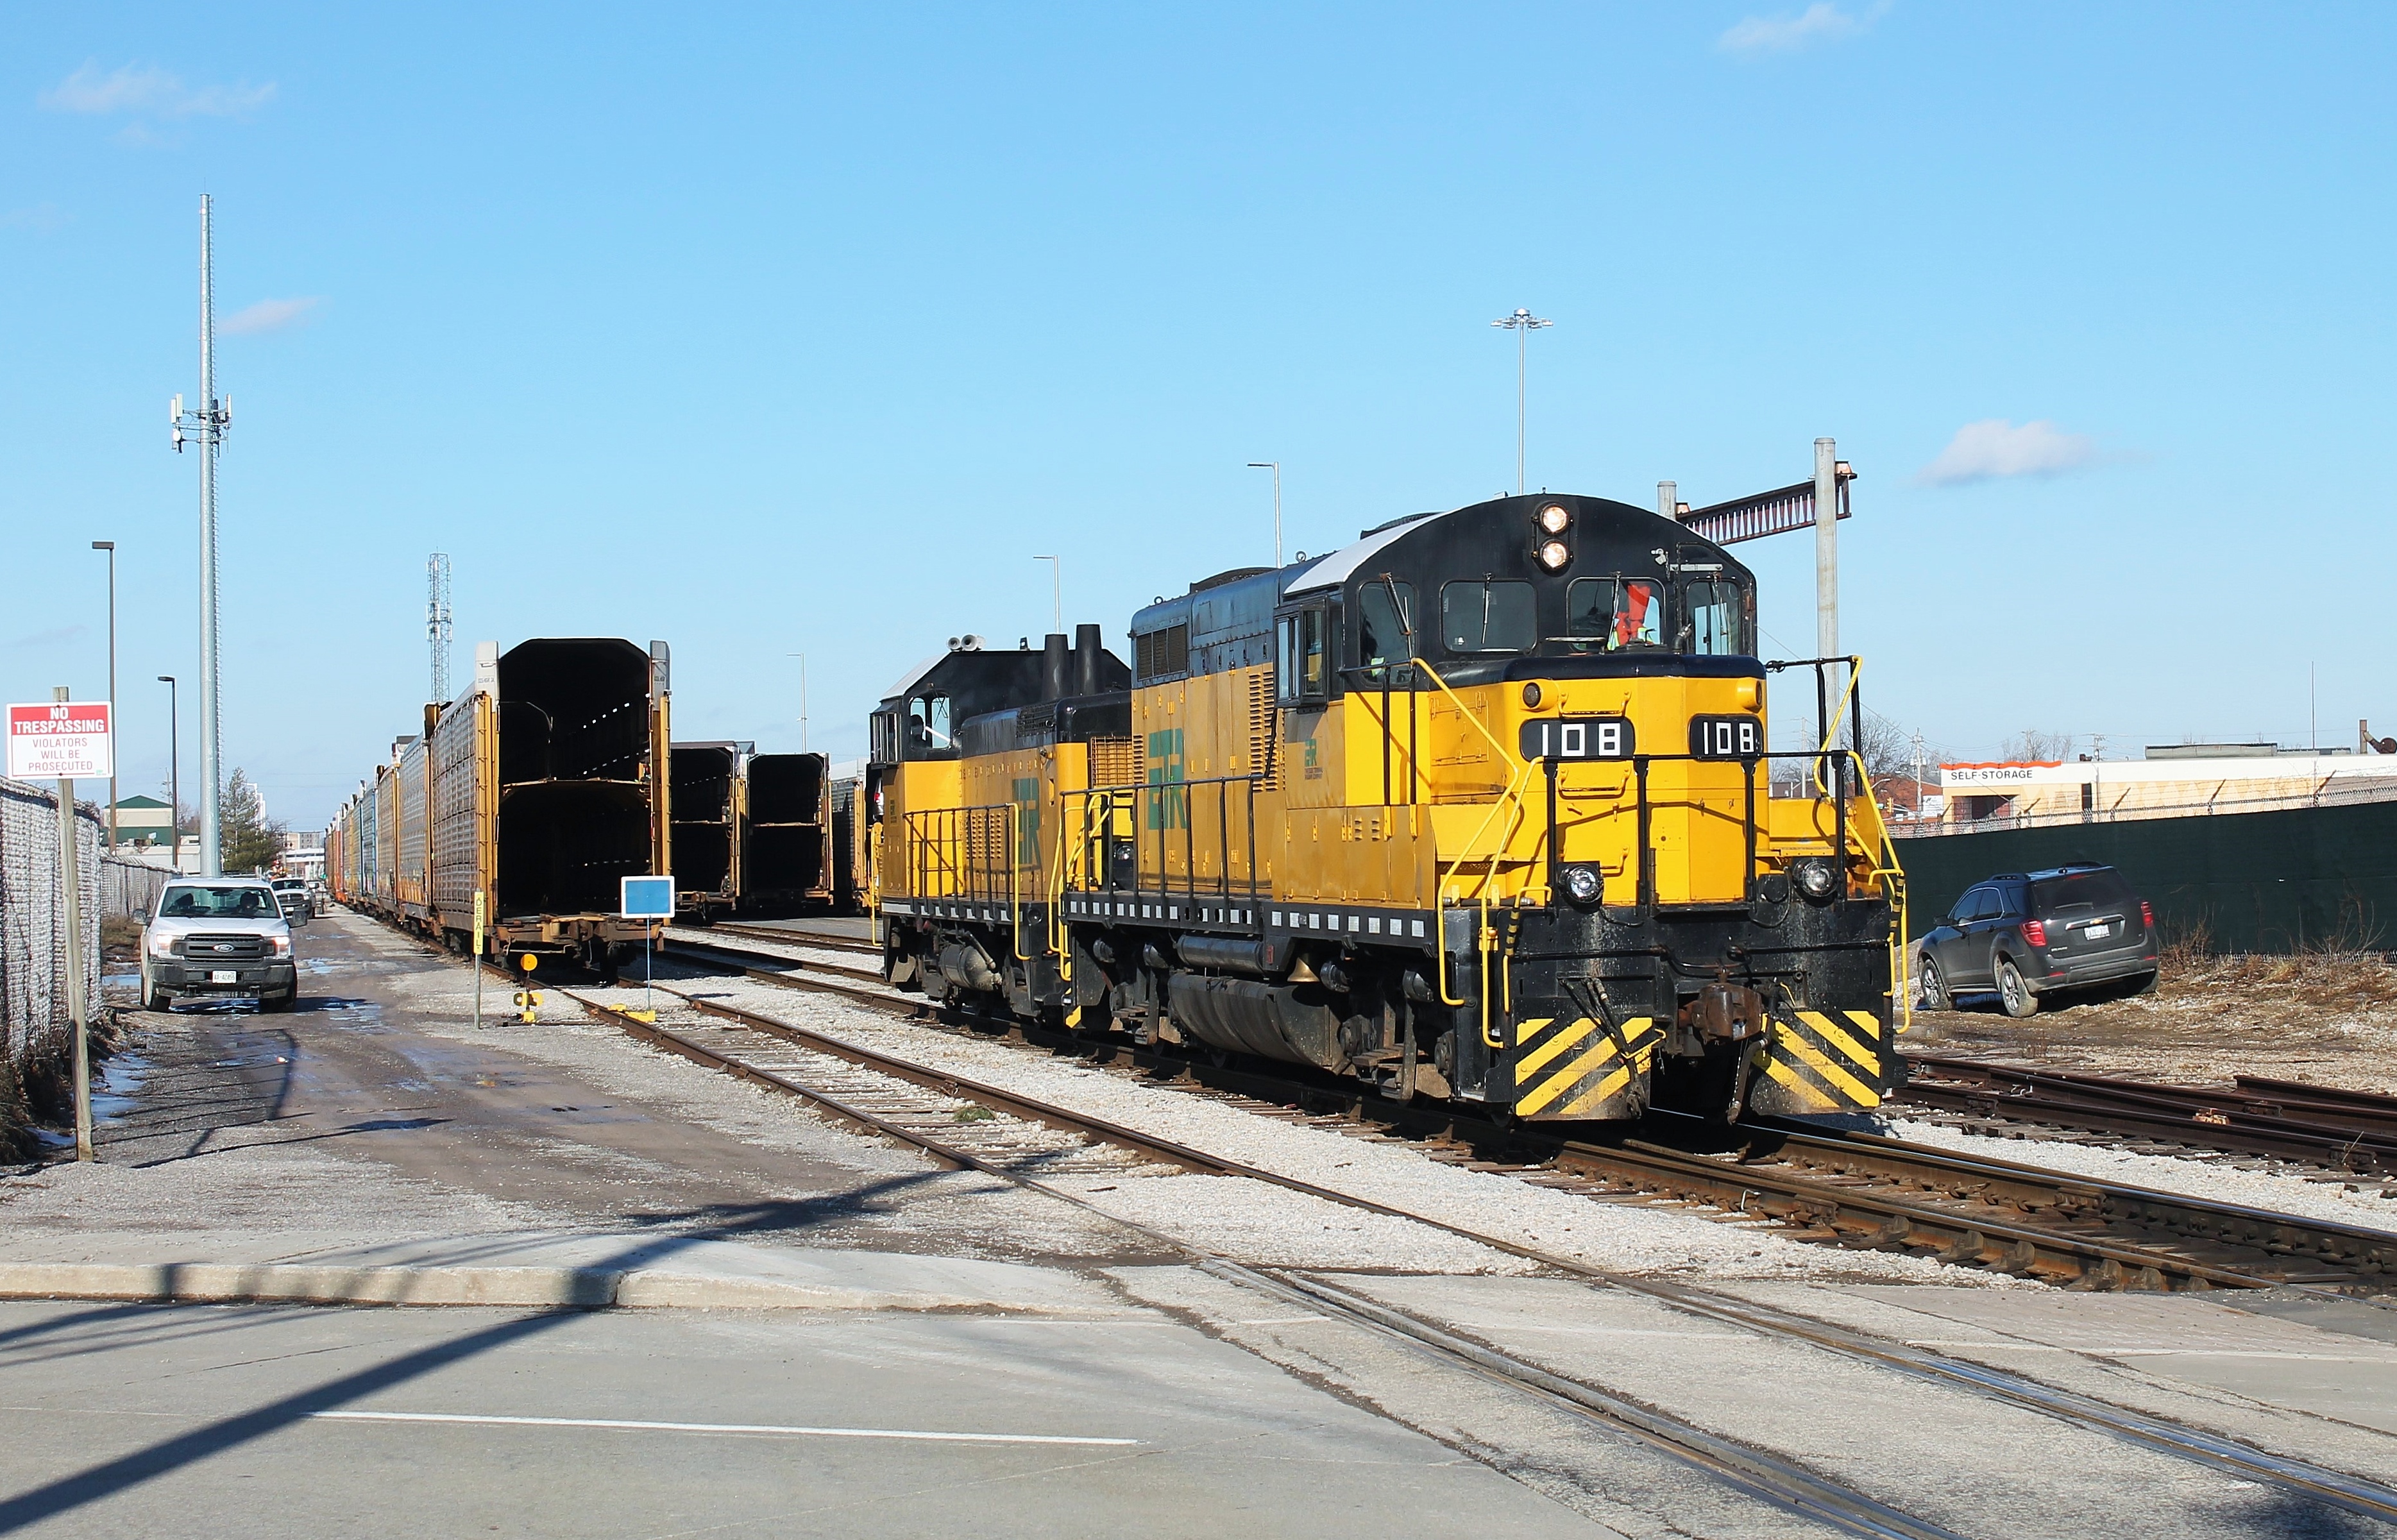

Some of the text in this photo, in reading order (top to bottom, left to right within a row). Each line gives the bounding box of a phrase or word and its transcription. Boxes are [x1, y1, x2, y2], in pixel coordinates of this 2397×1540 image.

[49, 707, 69, 720] NO
[14, 719, 105, 734] TRESPASSING
[33, 738, 88, 748] VIOLATORS
[1541, 723, 1621, 756] 108
[1703, 722, 1754, 754] 108
[41, 750, 80, 759] WILL BE
[28, 761, 93, 772] PROSECUTED
[1951, 770, 2033, 780] SELF-STORAGE
